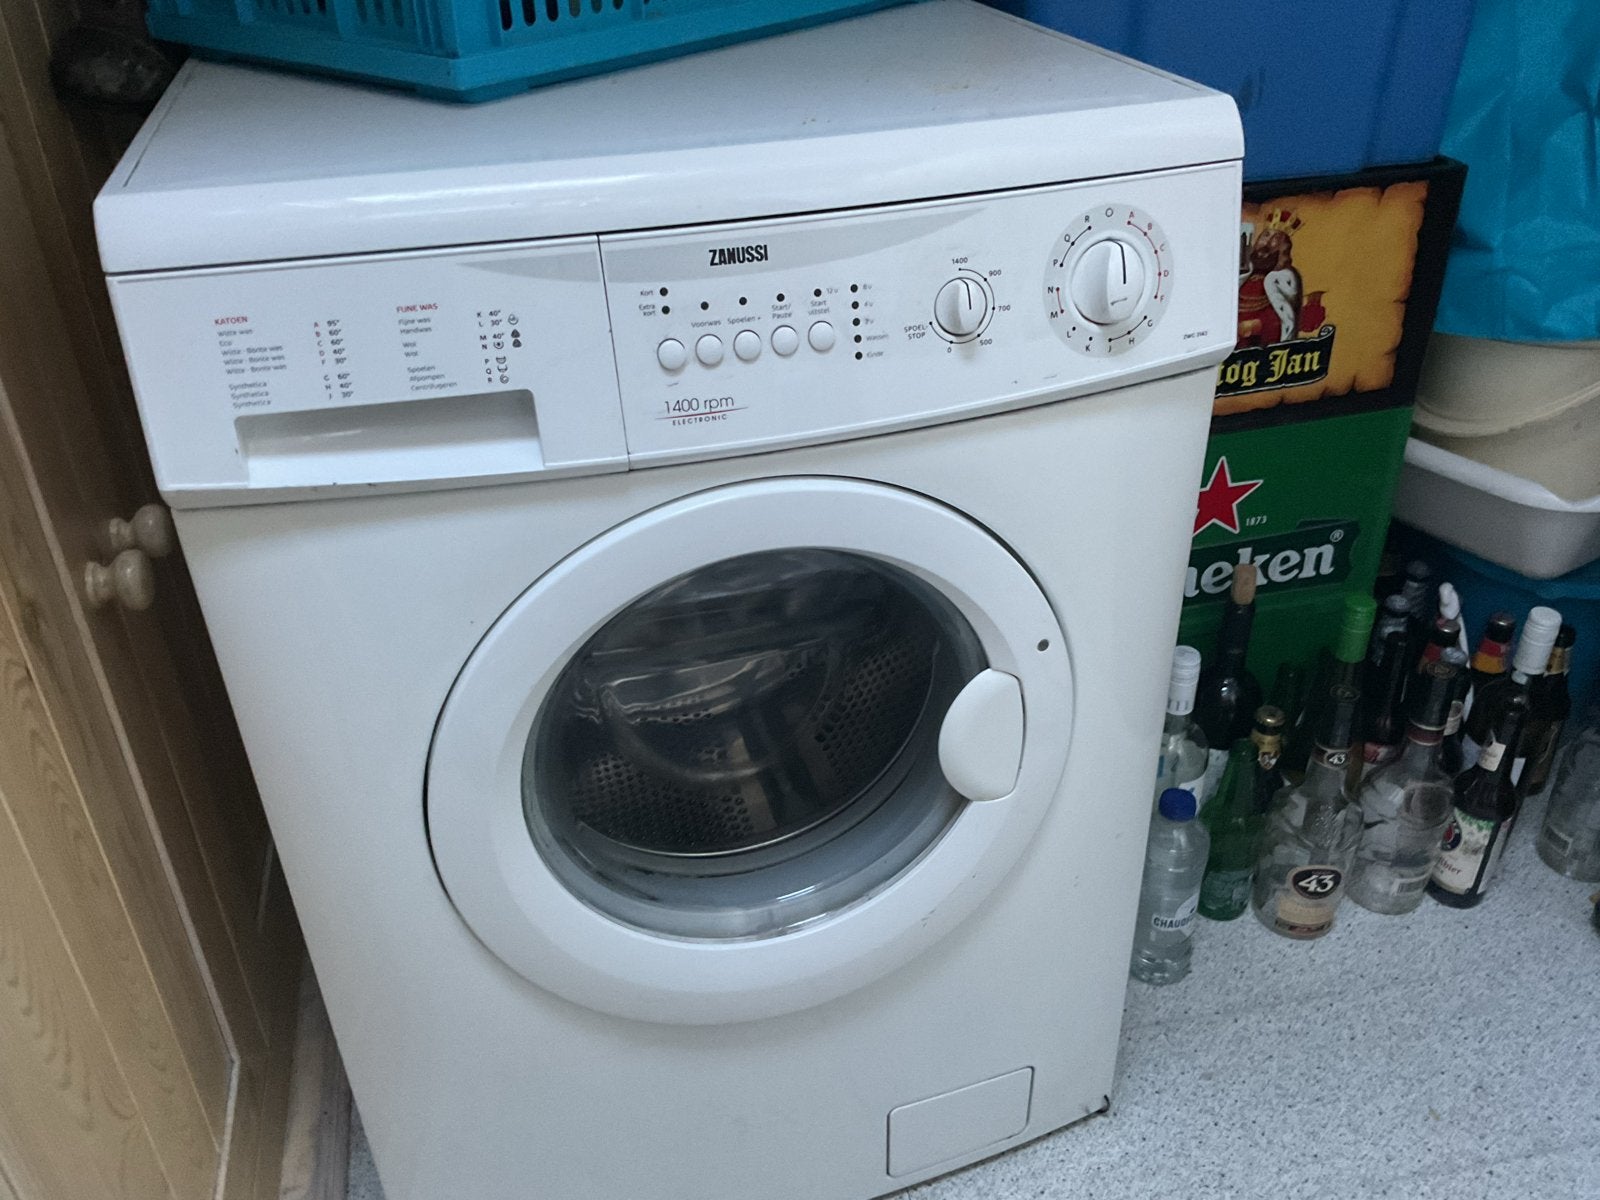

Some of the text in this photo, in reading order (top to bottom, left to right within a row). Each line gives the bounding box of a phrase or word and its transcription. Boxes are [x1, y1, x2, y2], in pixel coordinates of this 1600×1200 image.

[1084, 215, 1090, 223] R
[1147, 222, 1153, 230] B
[1064, 234, 1071, 243] Q
[1159, 243, 1166, 252] C
[708, 244, 769, 267] ZANUSSI
[951, 256, 969, 265] 1400
[1053, 259, 1059, 267] P
[988, 269, 1002, 277] 900
[1163, 270, 1170, 278] D
[640, 288, 654, 296] Kort
[1047, 286, 1054, 294] N
[419, 302, 439, 311] WAS
[639, 303, 656, 311] Extra
[810, 299, 827, 307] Start
[998, 304, 1011, 312] 700
[1050, 311, 1058, 319] M
[214, 316, 248, 325] KATOEN
[727, 316, 756, 326] Spoelen
[908, 331, 926, 340] STOP
[1066, 330, 1072, 338] L
[979, 338, 993, 346] 500
[1128, 337, 1135, 345] H
[1085, 344, 1091, 352] K
[1264, 348, 1321, 384] Jan
[664, 396, 735, 414] 1400 rpm
[672, 413, 728, 426] ELECTRONIC
[1245, 515, 1268, 527] 1873
[1328, 752, 1346, 765] 43
[1297, 873, 1336, 893] 43
